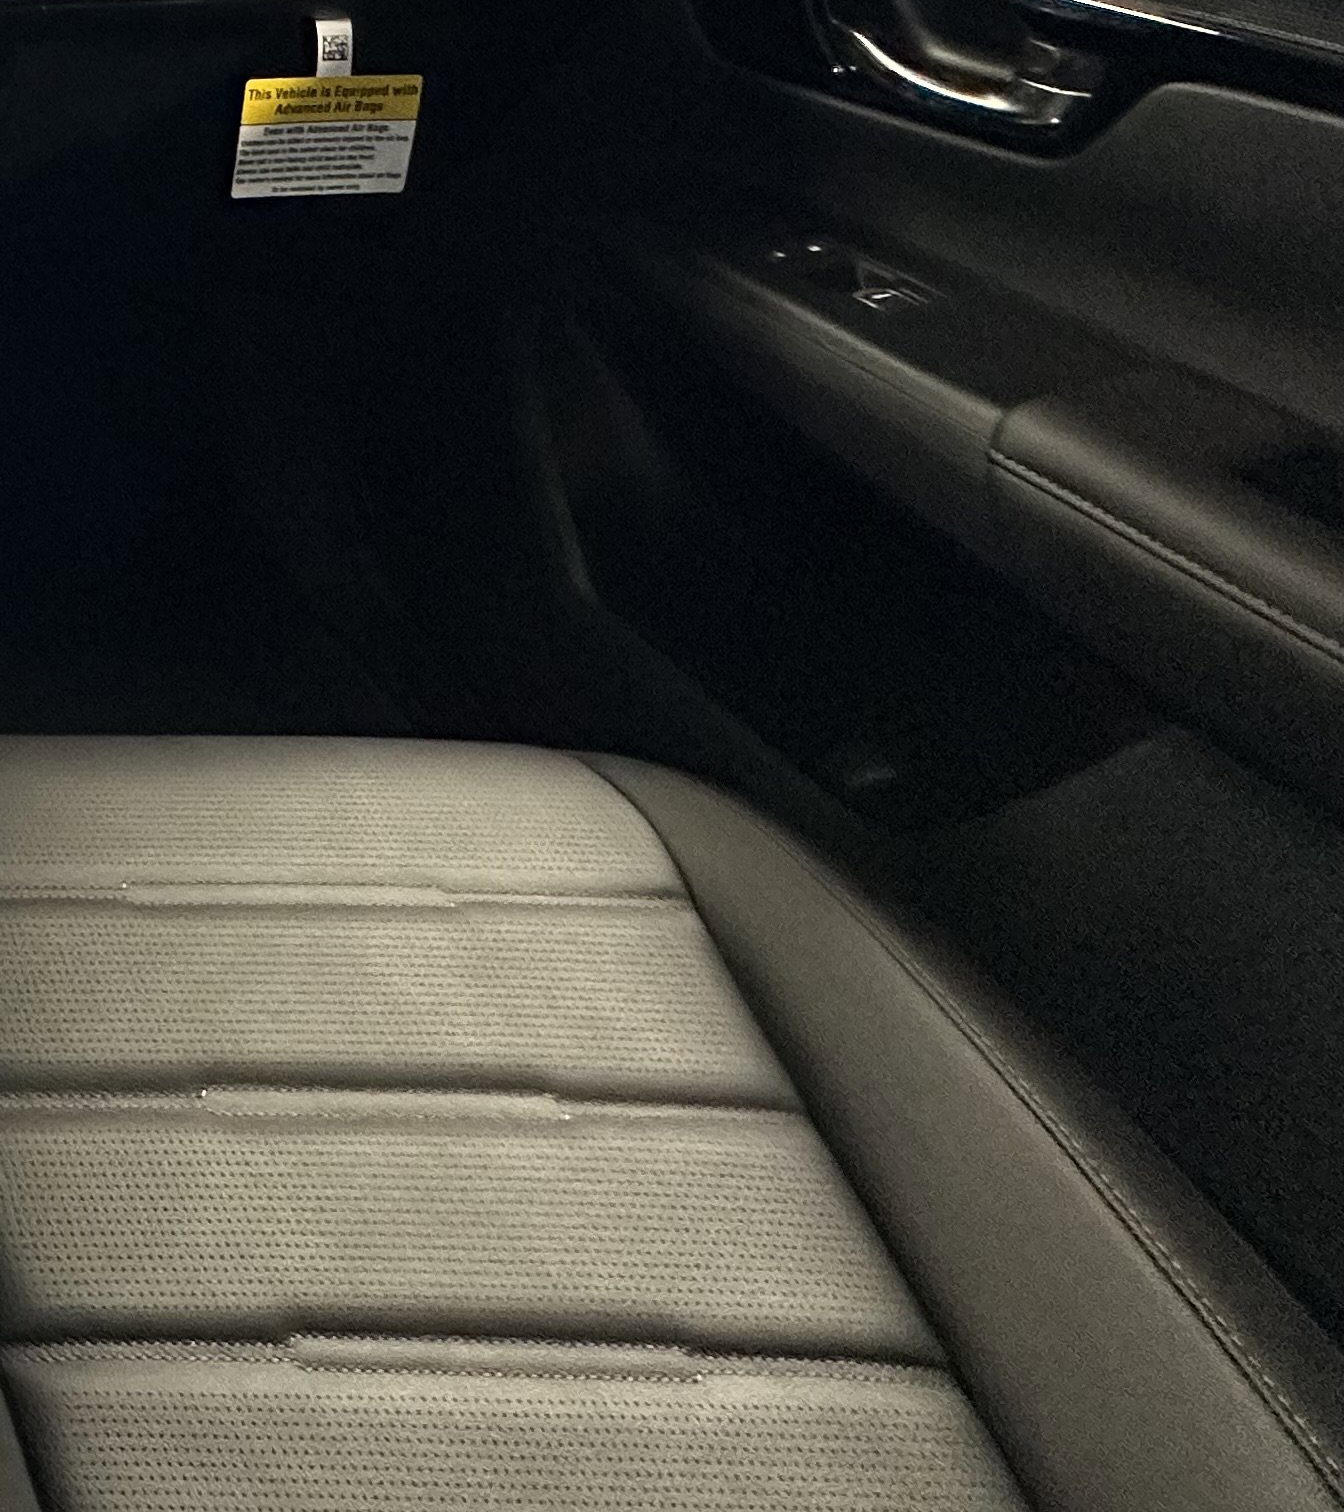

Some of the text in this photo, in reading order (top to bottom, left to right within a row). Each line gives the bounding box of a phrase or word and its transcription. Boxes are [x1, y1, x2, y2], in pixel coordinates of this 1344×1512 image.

[248, 83, 419, 101] This Vehicle is Equipped with
[274, 100, 384, 116] Advanced Air Bags
